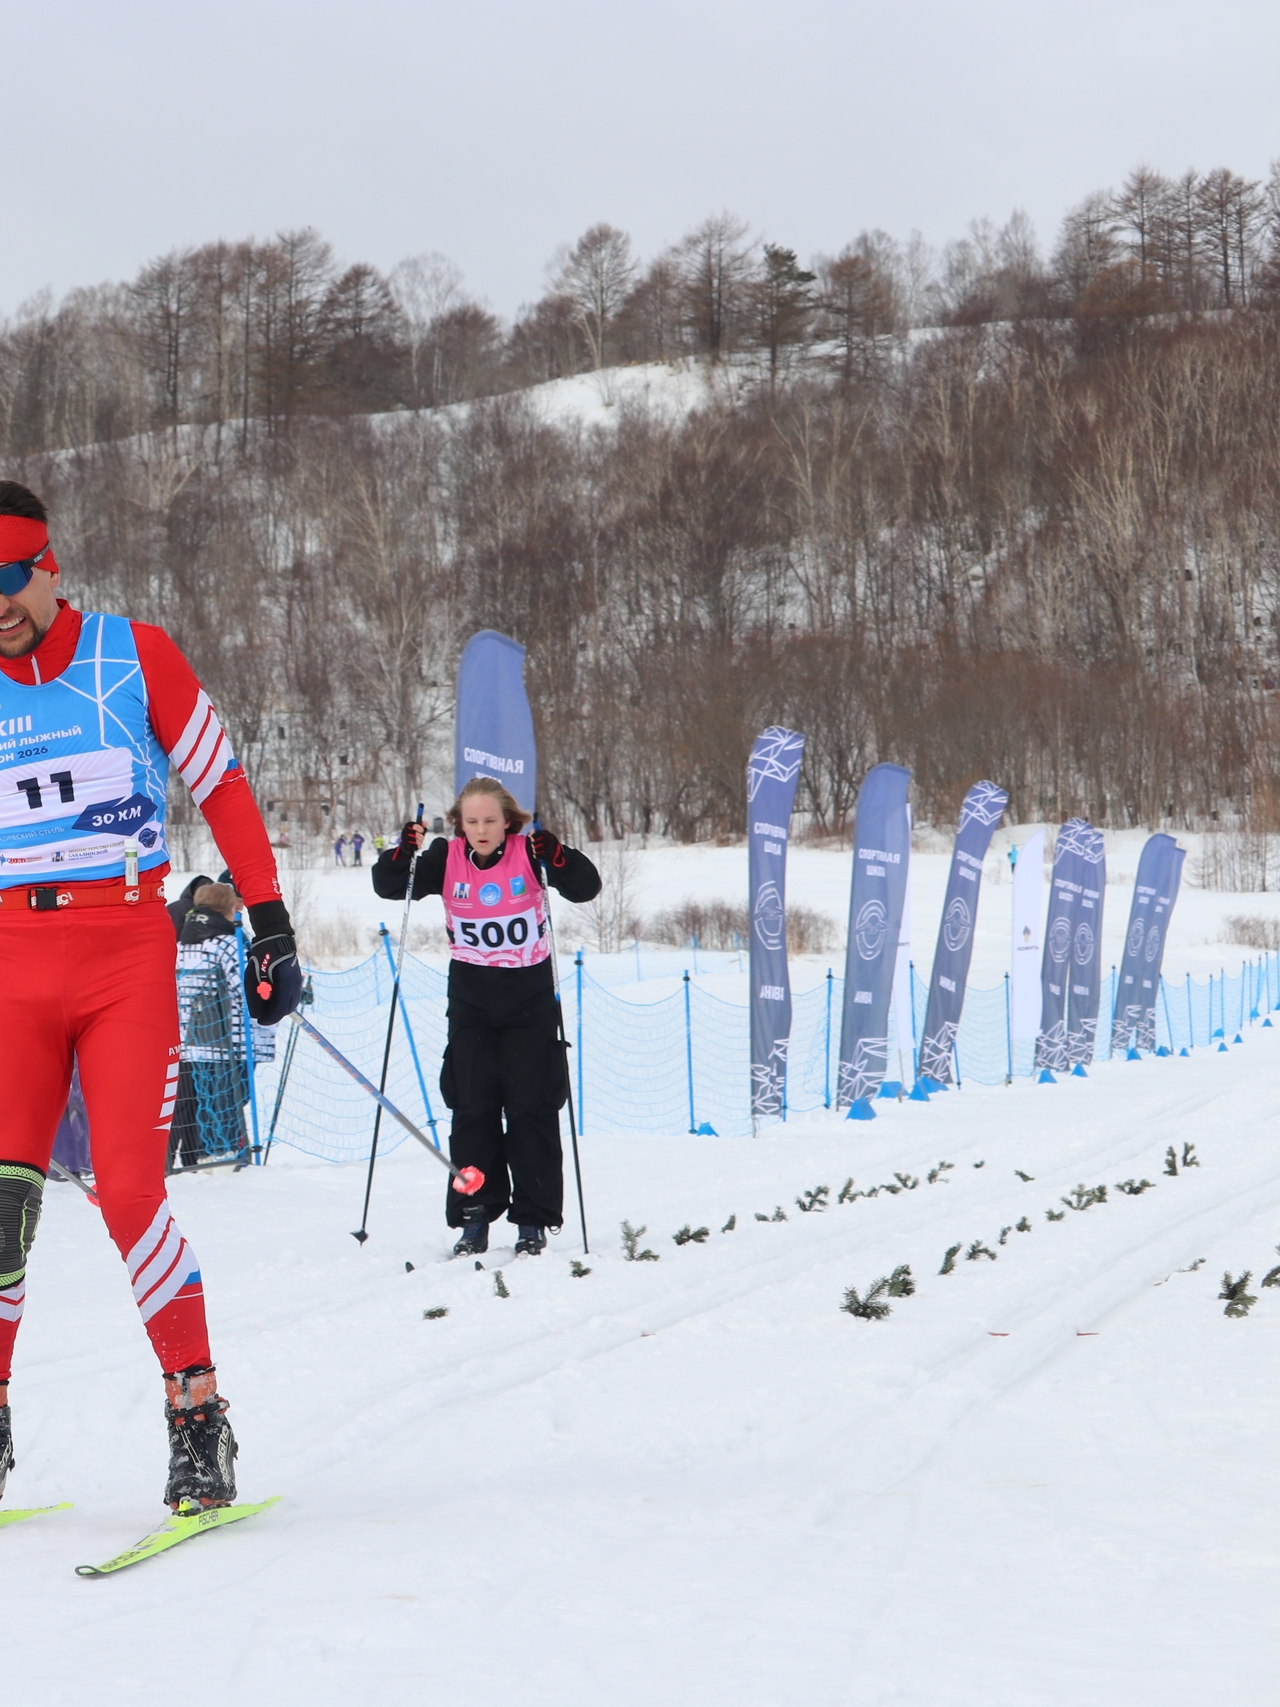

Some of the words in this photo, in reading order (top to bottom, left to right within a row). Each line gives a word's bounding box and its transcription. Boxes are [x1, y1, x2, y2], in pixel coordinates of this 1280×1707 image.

[18, 725, 82, 746] ЛЫЖНЫЙ
[17, 746, 48, 759] 2026
[16, 771, 75, 809] 11
[92, 813, 115, 827] 30
[38, 826, 65, 836] СТИЛЬ
[460, 917, 528, 948] 500
[199, 1510, 220, 1527] FISCHER
